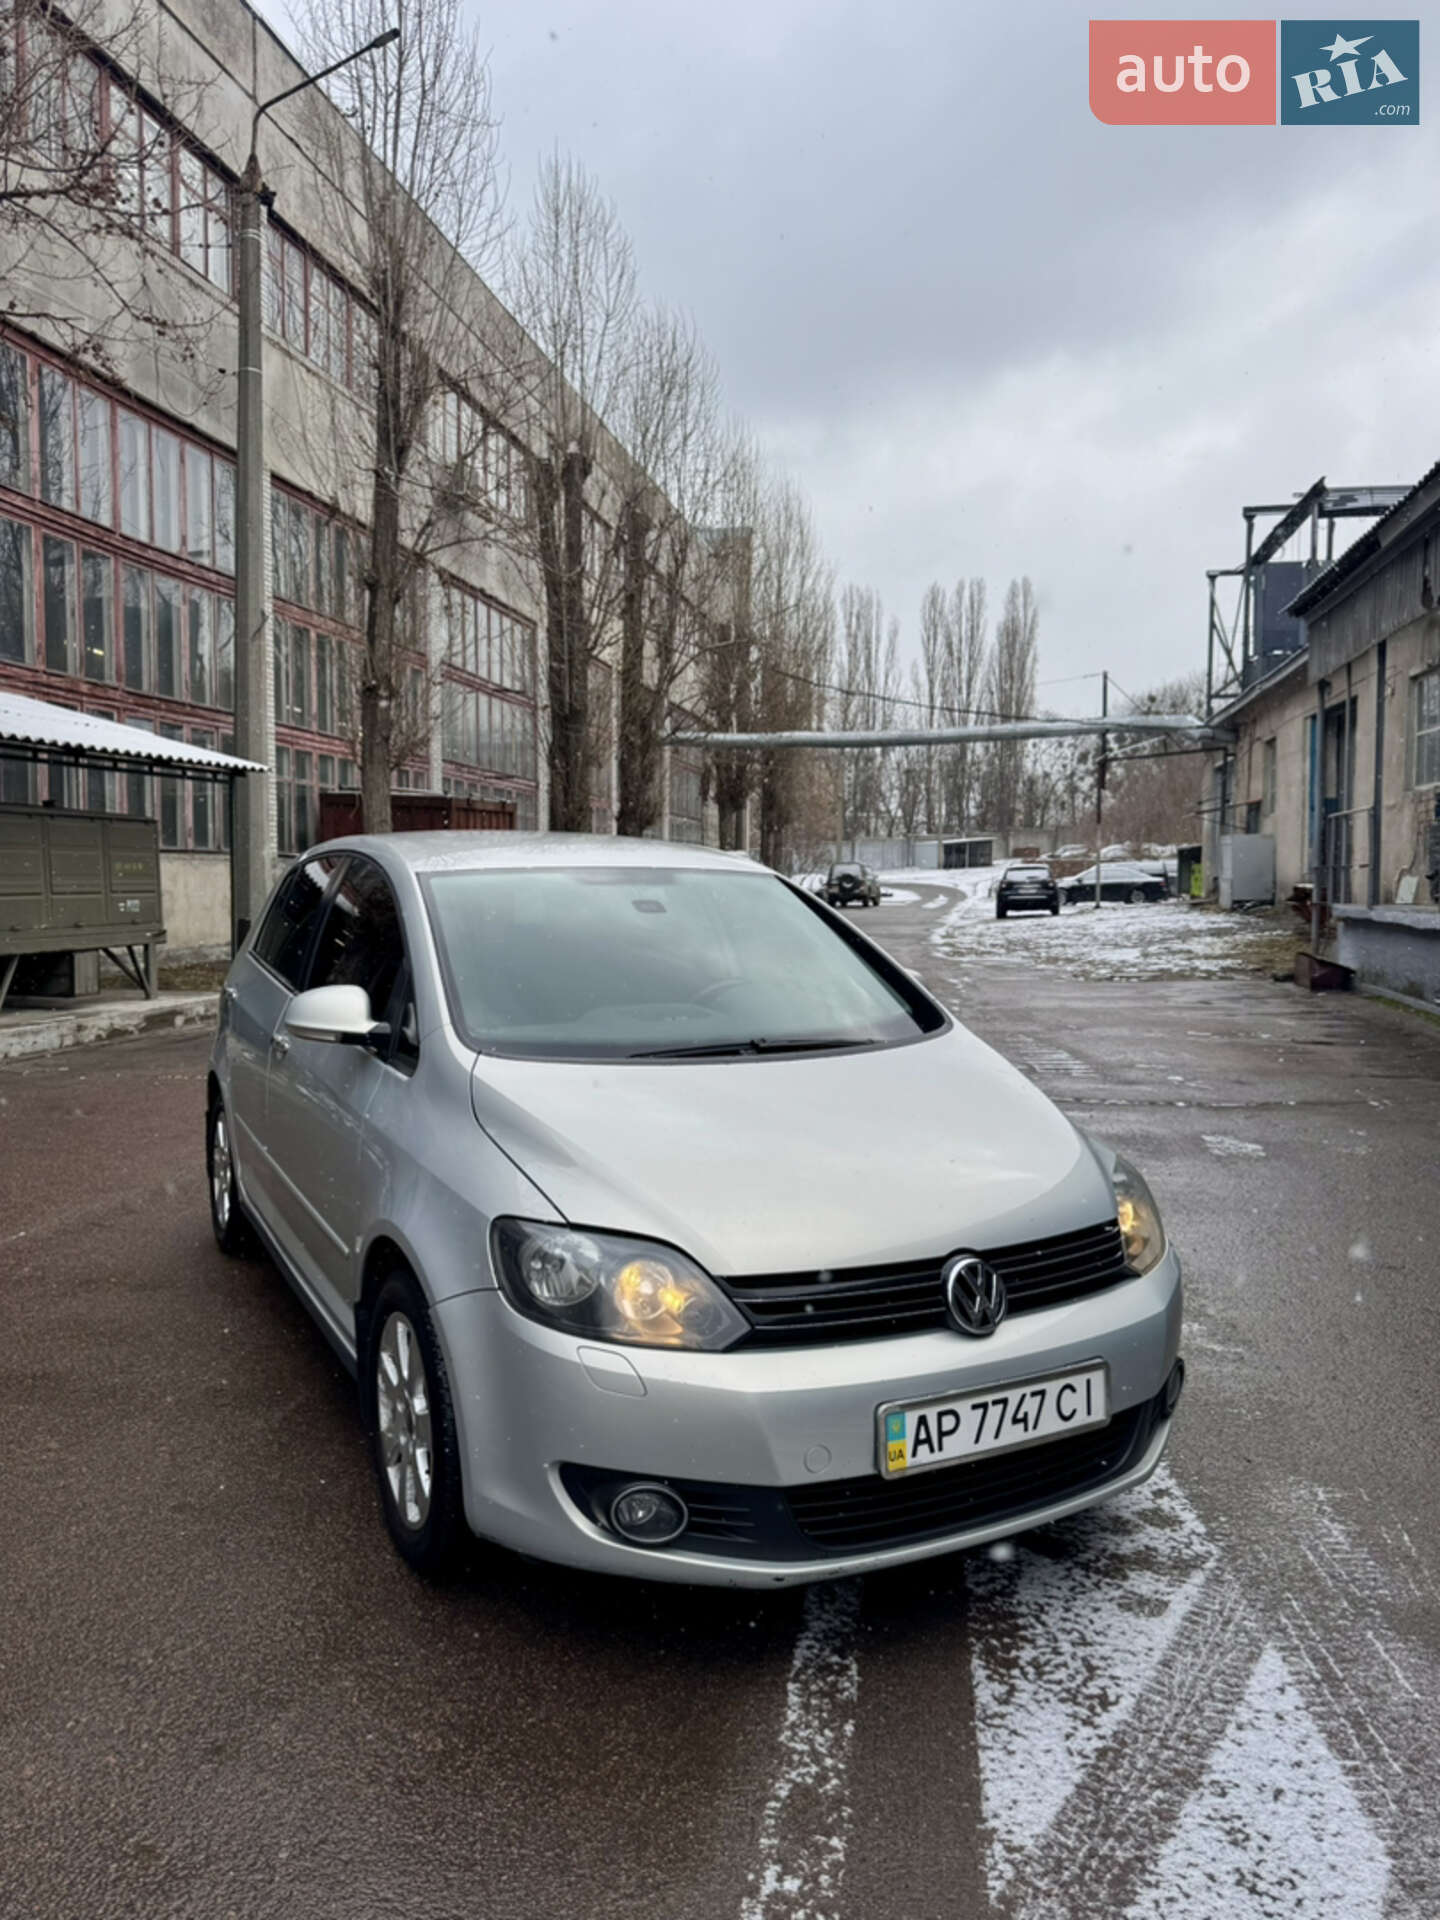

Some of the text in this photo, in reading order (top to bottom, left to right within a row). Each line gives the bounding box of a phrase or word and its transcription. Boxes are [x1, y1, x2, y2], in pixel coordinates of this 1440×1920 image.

[911, 1378, 1092, 1458] AP 7747 CI
[888, 1448, 905, 1462] UA
